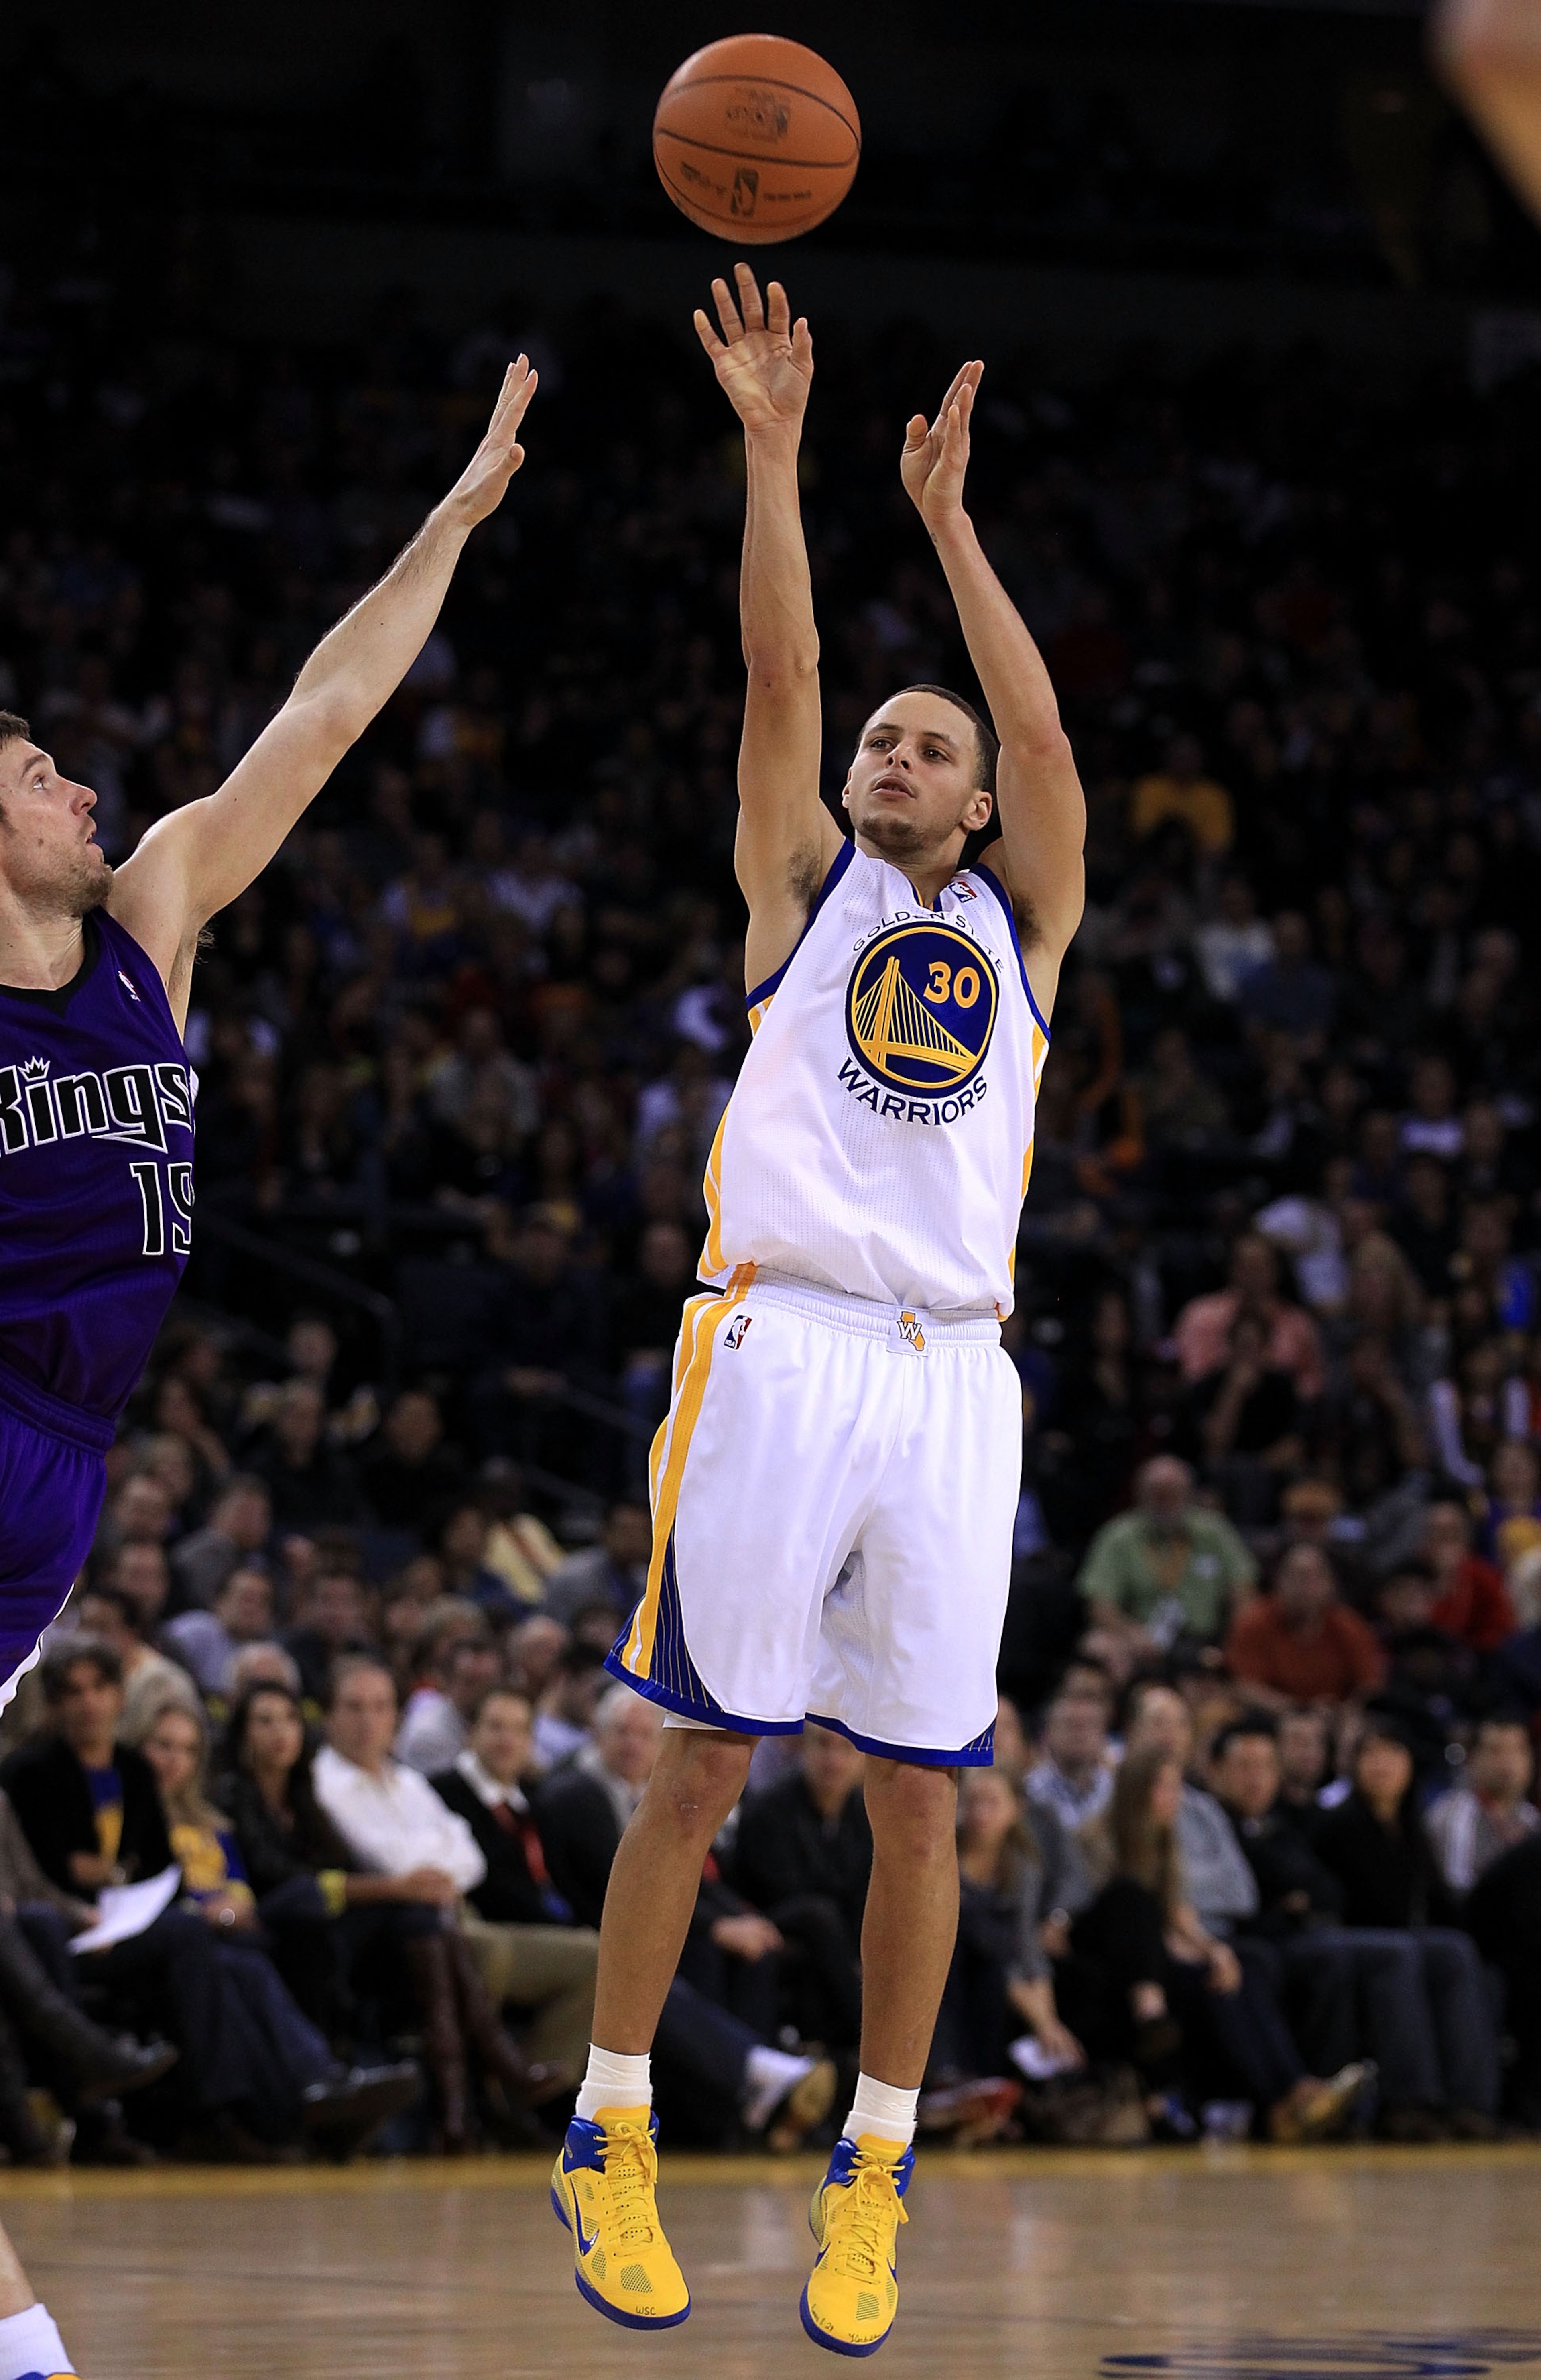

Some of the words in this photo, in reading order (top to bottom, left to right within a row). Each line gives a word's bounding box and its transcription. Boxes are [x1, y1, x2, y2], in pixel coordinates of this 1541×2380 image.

[923, 961, 980, 1008] 30
[837, 1057, 987, 1126] WARRIORS
[129, 1162, 195, 1255] 19
[896, 1321, 923, 1341] W
[636, 2306, 656, 2315] WSC
